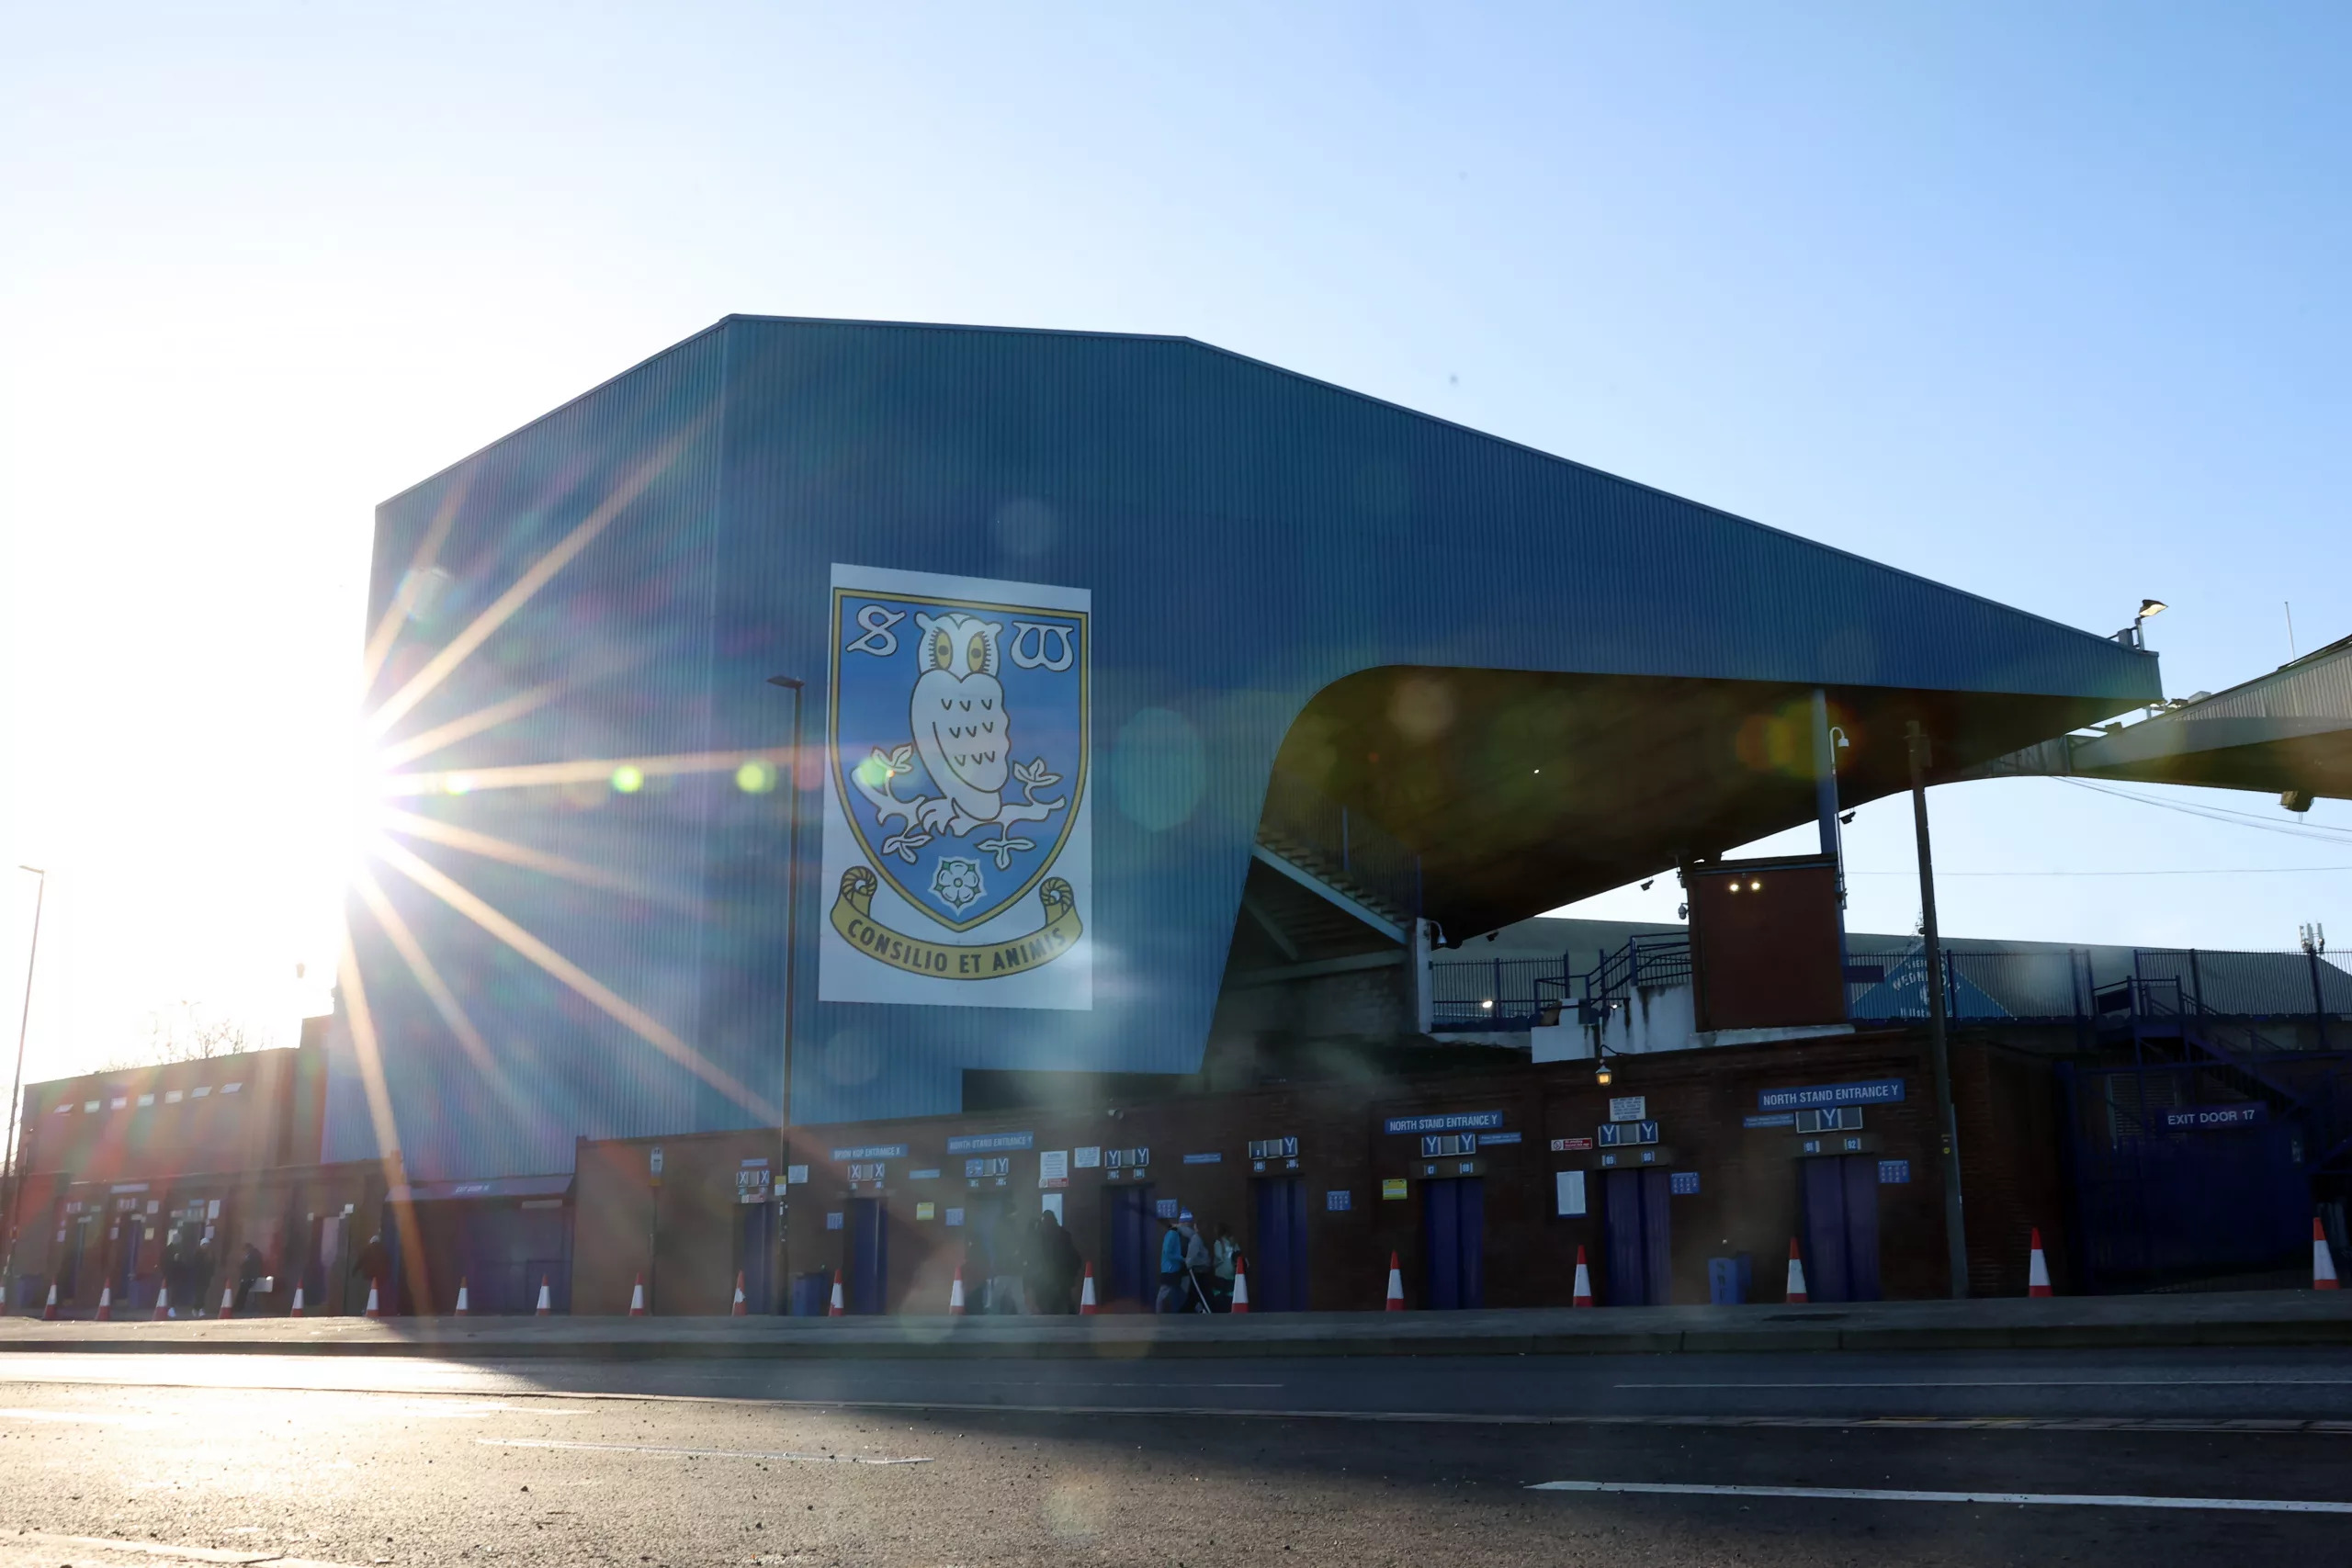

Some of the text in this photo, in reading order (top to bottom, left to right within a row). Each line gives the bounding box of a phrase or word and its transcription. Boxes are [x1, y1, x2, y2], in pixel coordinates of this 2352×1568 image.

[846, 604, 1074, 671] S W
[847, 919, 1066, 974] CONSILIO ET ANIMIS
[1763, 1084, 1899, 1106] NORTH STAND ENTRANCE Y
[1389, 1113, 1498, 1132] NORTH STAND ENTRANCE Y
[1822, 1108, 1836, 1127] Y
[2168, 1109, 2256, 1125] EXIT DOOR 17
[1602, 1122, 1654, 1142] Y Y
[1284, 1137, 1295, 1153] Y
[1425, 1136, 1438, 1153] Y
[1461, 1134, 1473, 1151] Y
[1000, 1158, 1006, 1172] Y
[1108, 1150, 1118, 1165] Y
[1138, 1148, 1147, 1163] Y
[852, 1163, 882, 1179] X X
